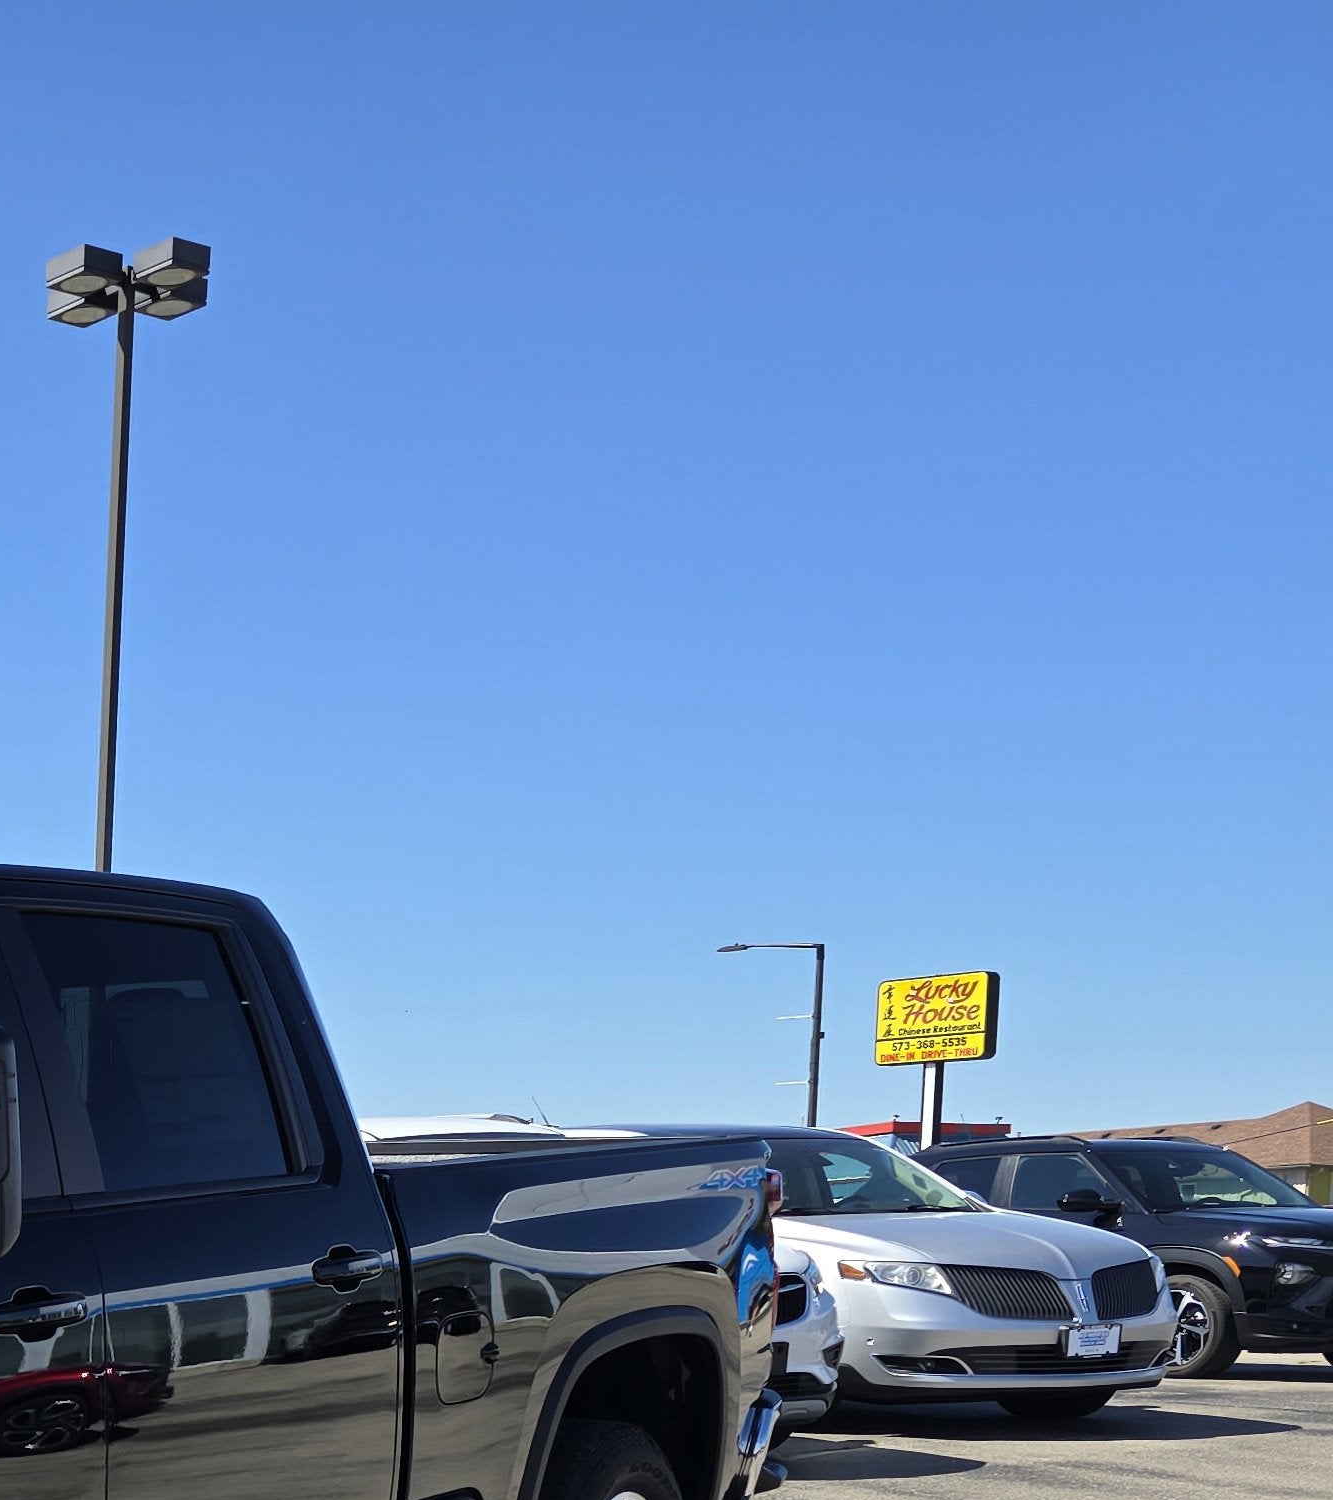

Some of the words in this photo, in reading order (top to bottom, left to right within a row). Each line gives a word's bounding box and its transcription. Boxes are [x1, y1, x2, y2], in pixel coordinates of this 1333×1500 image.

[905, 979, 979, 1004] Lucky
[902, 1004, 980, 1025] House
[899, 1028, 931, 1036] Chinese
[933, 1022, 981, 1034] Restaurant
[880, 1052, 915, 1063] DINE-IN
[921, 1047, 978, 1060] DRIVE-THRU
